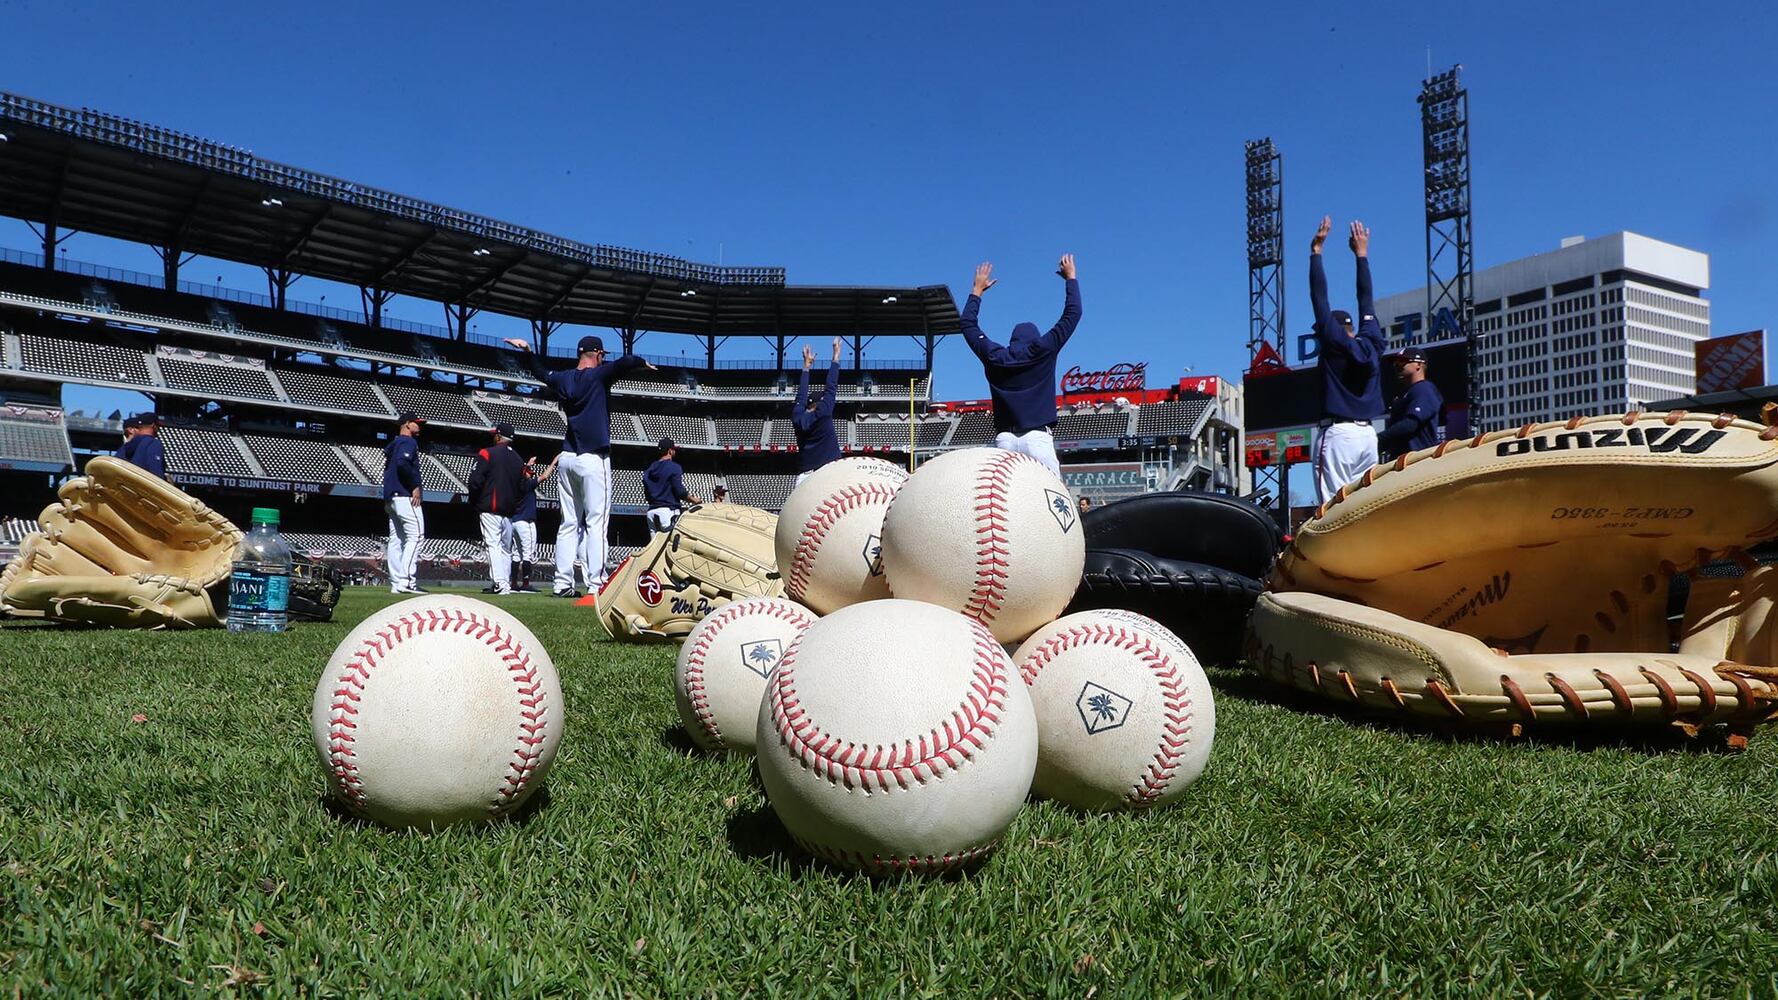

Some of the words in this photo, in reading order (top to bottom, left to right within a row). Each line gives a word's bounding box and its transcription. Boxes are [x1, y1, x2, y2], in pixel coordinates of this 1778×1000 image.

[171, 473, 220, 486] WELCOME
[222, 476, 236, 487] TO
[239, 477, 291, 491] SUNTRUST
[293, 482, 320, 492] PARK
[1065, 471, 1137, 486] TERRACE
[1551, 507, 1695, 519] GMP2-335C
